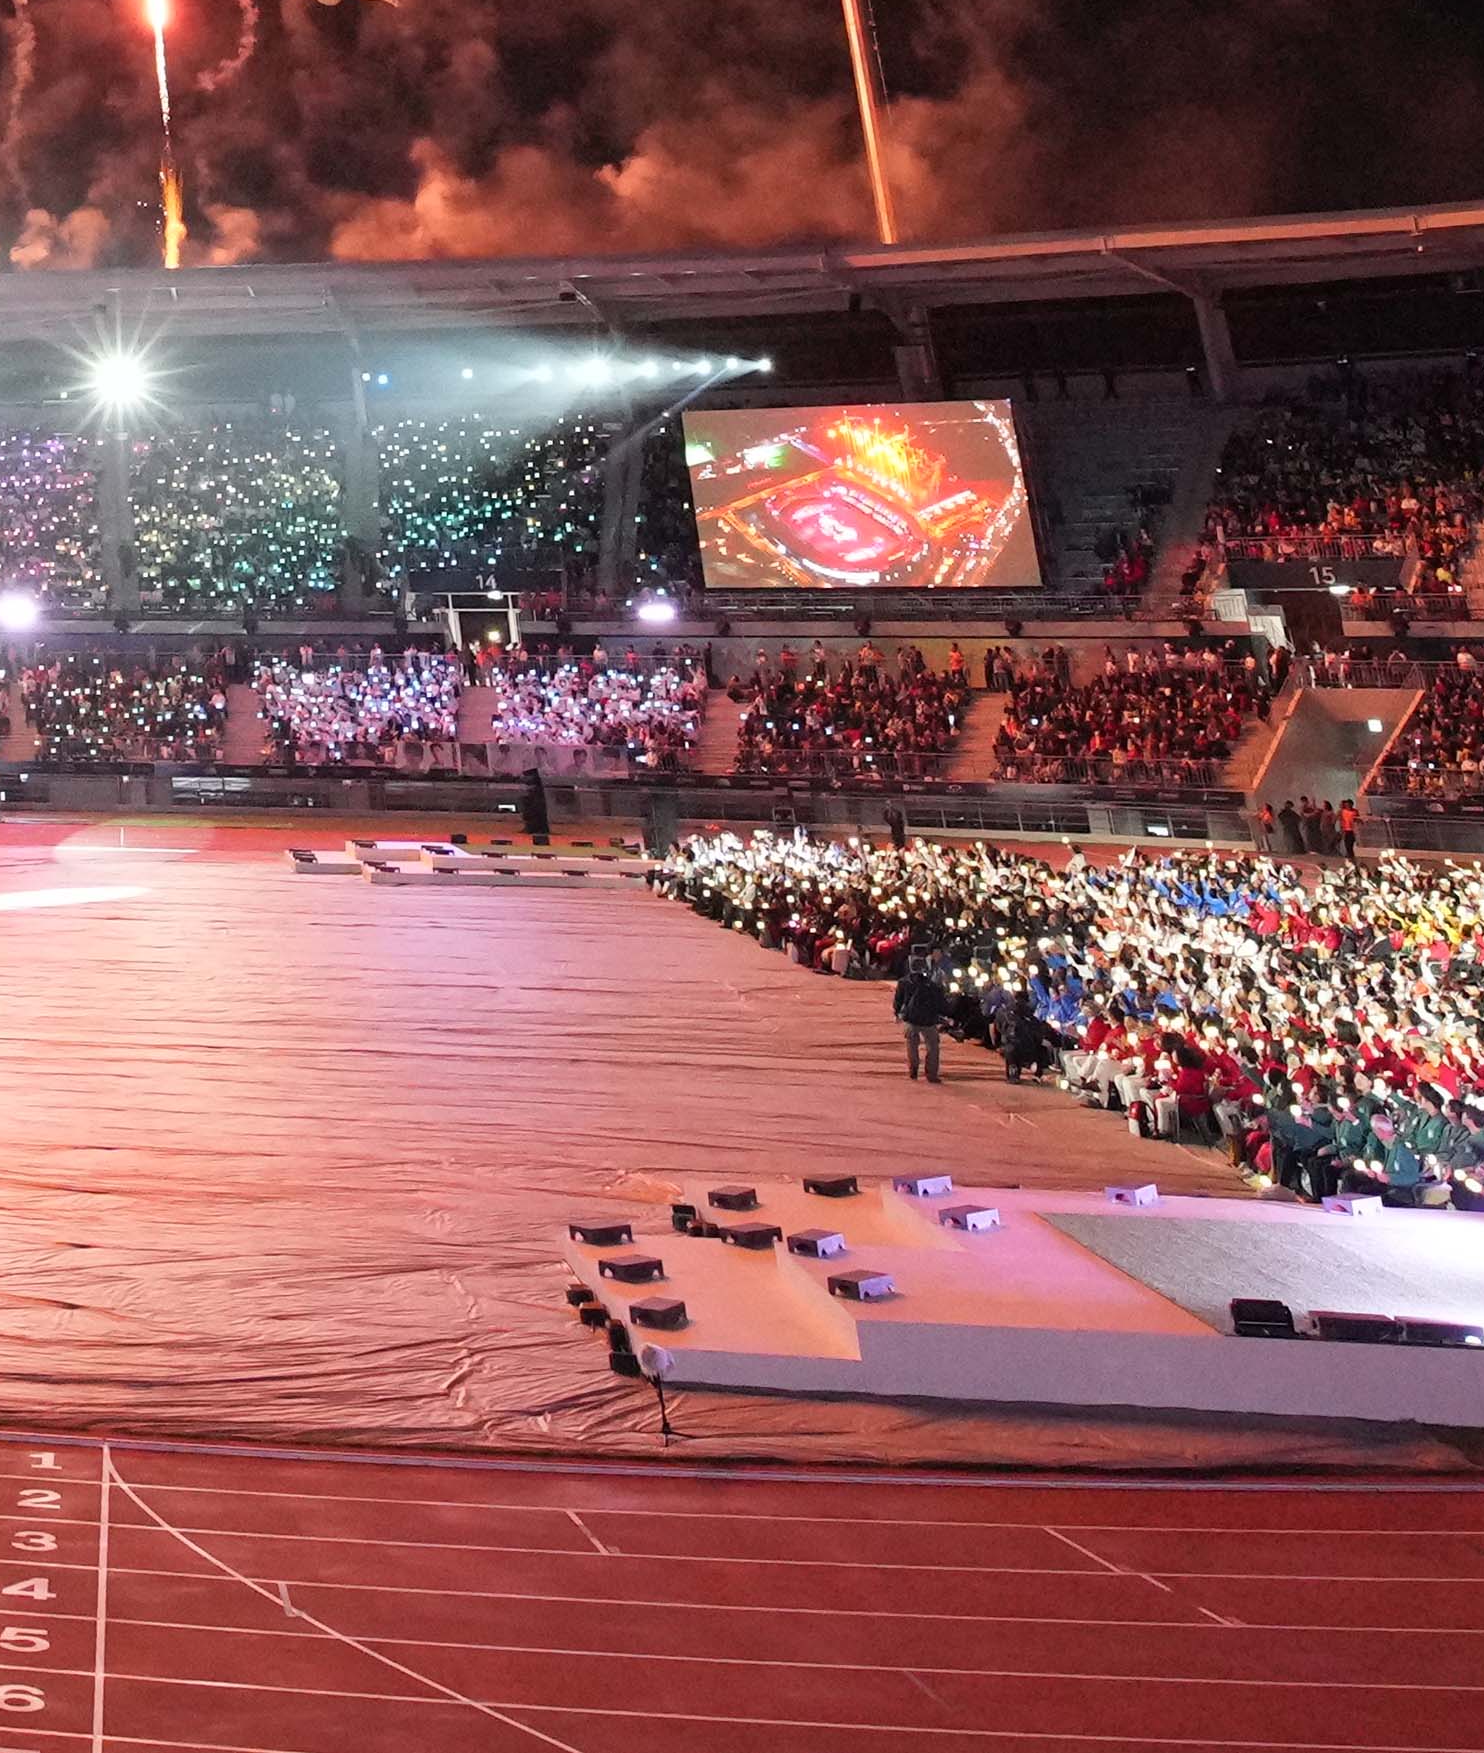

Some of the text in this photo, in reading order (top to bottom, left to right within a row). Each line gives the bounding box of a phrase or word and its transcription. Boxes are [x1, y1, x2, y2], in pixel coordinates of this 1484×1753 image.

[476, 574, 497, 590] 14
[1308, 566, 1337, 586] 15
[29, 1451, 63, 1470] 1
[16, 1488, 62, 1510] 2
[10, 1530, 58, 1552] 3
[1, 1577, 56, 1601] 4
